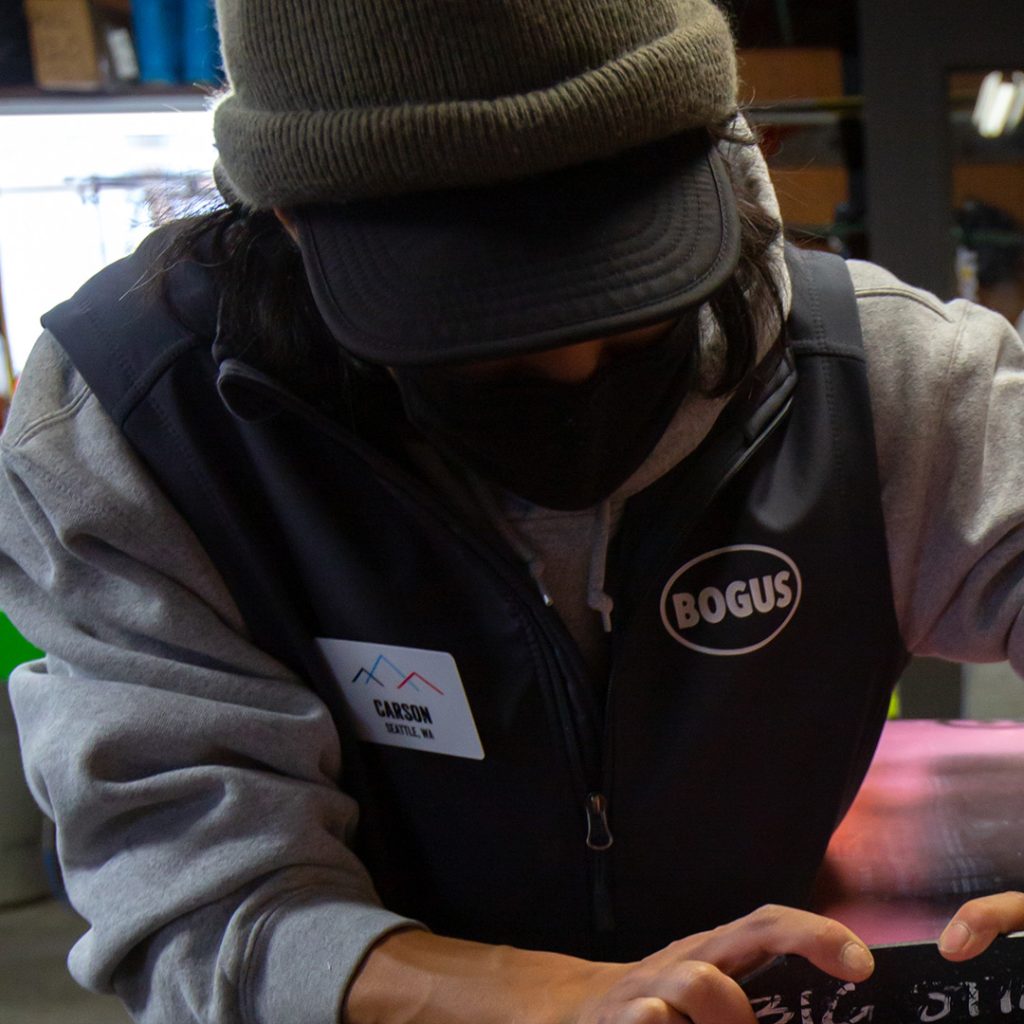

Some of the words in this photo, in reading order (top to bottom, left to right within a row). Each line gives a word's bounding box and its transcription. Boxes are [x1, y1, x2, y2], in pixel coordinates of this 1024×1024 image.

[672, 570, 793, 630] BOGUS
[373, 699, 433, 724] CARSON
[385, 722, 420, 739] SEATTLE,
[420, 728, 434, 739] WA
